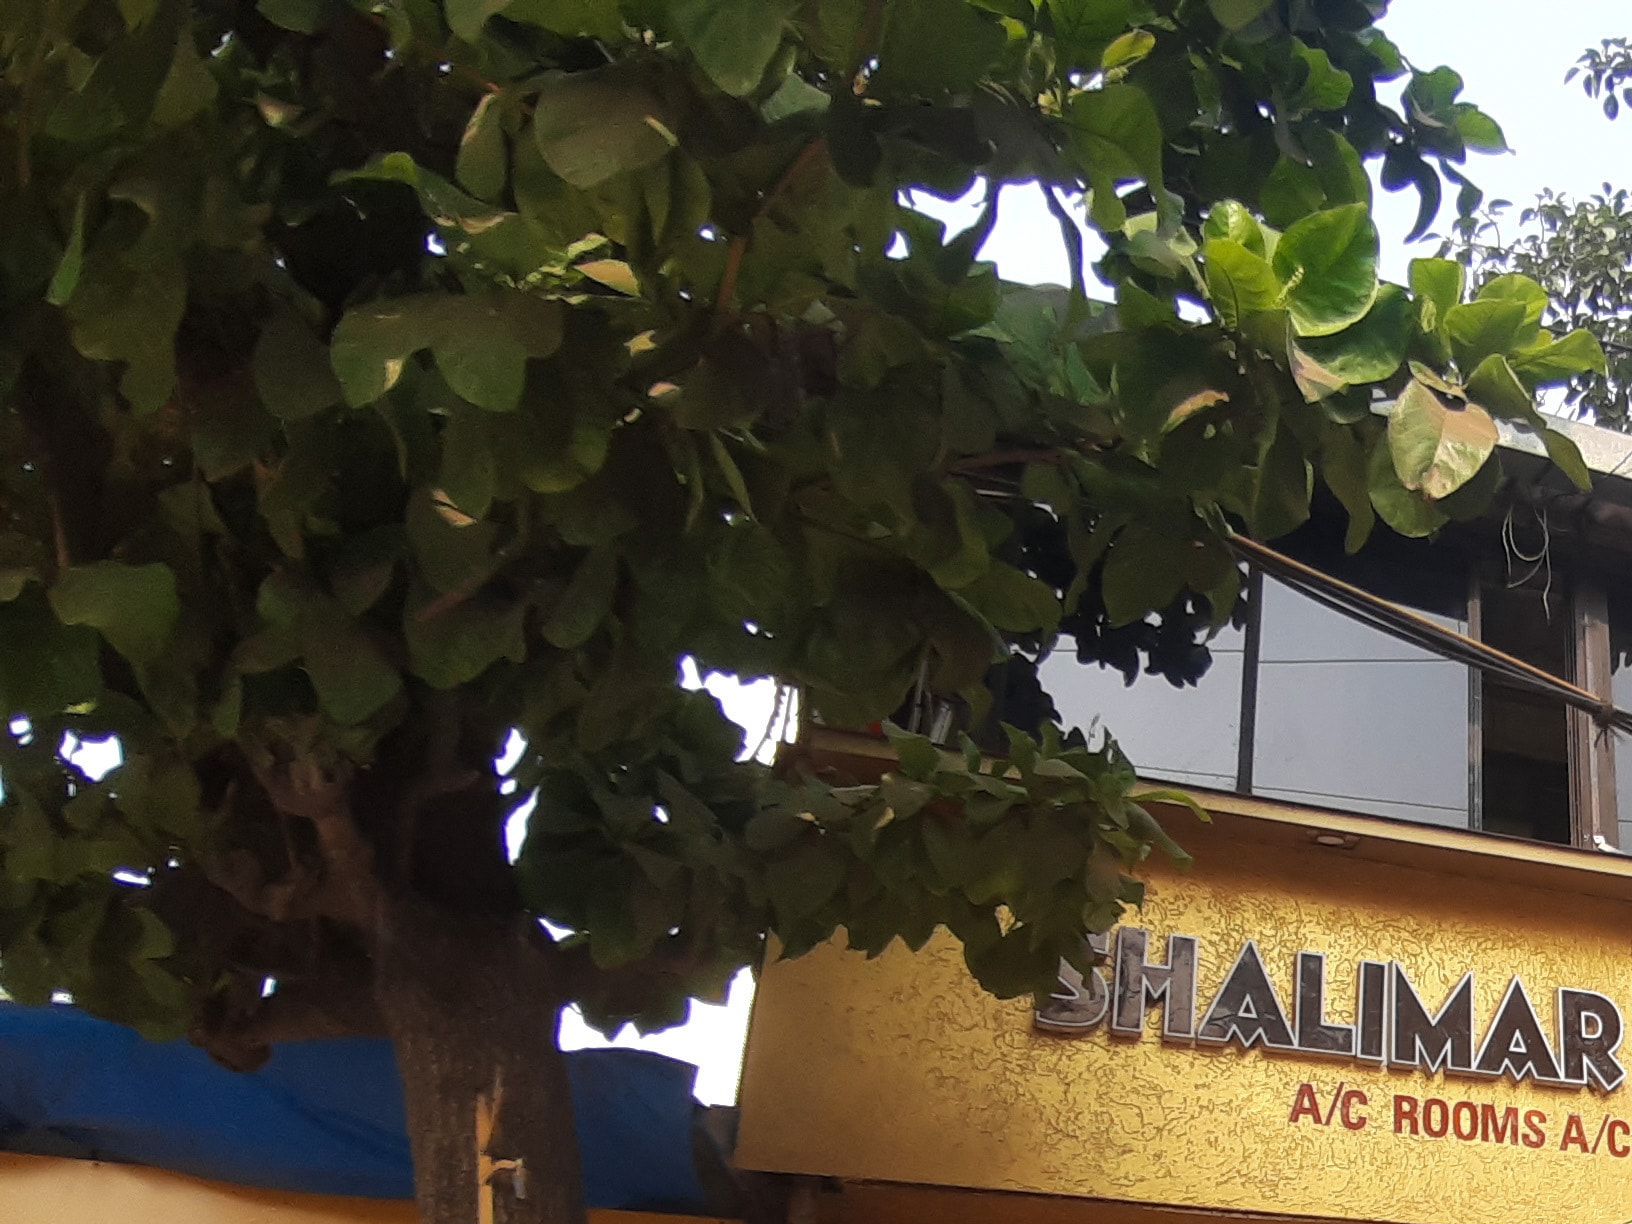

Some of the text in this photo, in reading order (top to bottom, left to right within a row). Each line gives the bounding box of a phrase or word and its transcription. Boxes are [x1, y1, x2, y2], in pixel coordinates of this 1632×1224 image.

[1033, 926, 1626, 1092] SHALIMAR
[1290, 1081, 1368, 1131] A/C
[1393, 1094, 1547, 1149] ROOMS
[1560, 1113, 1631, 1158] A/C
